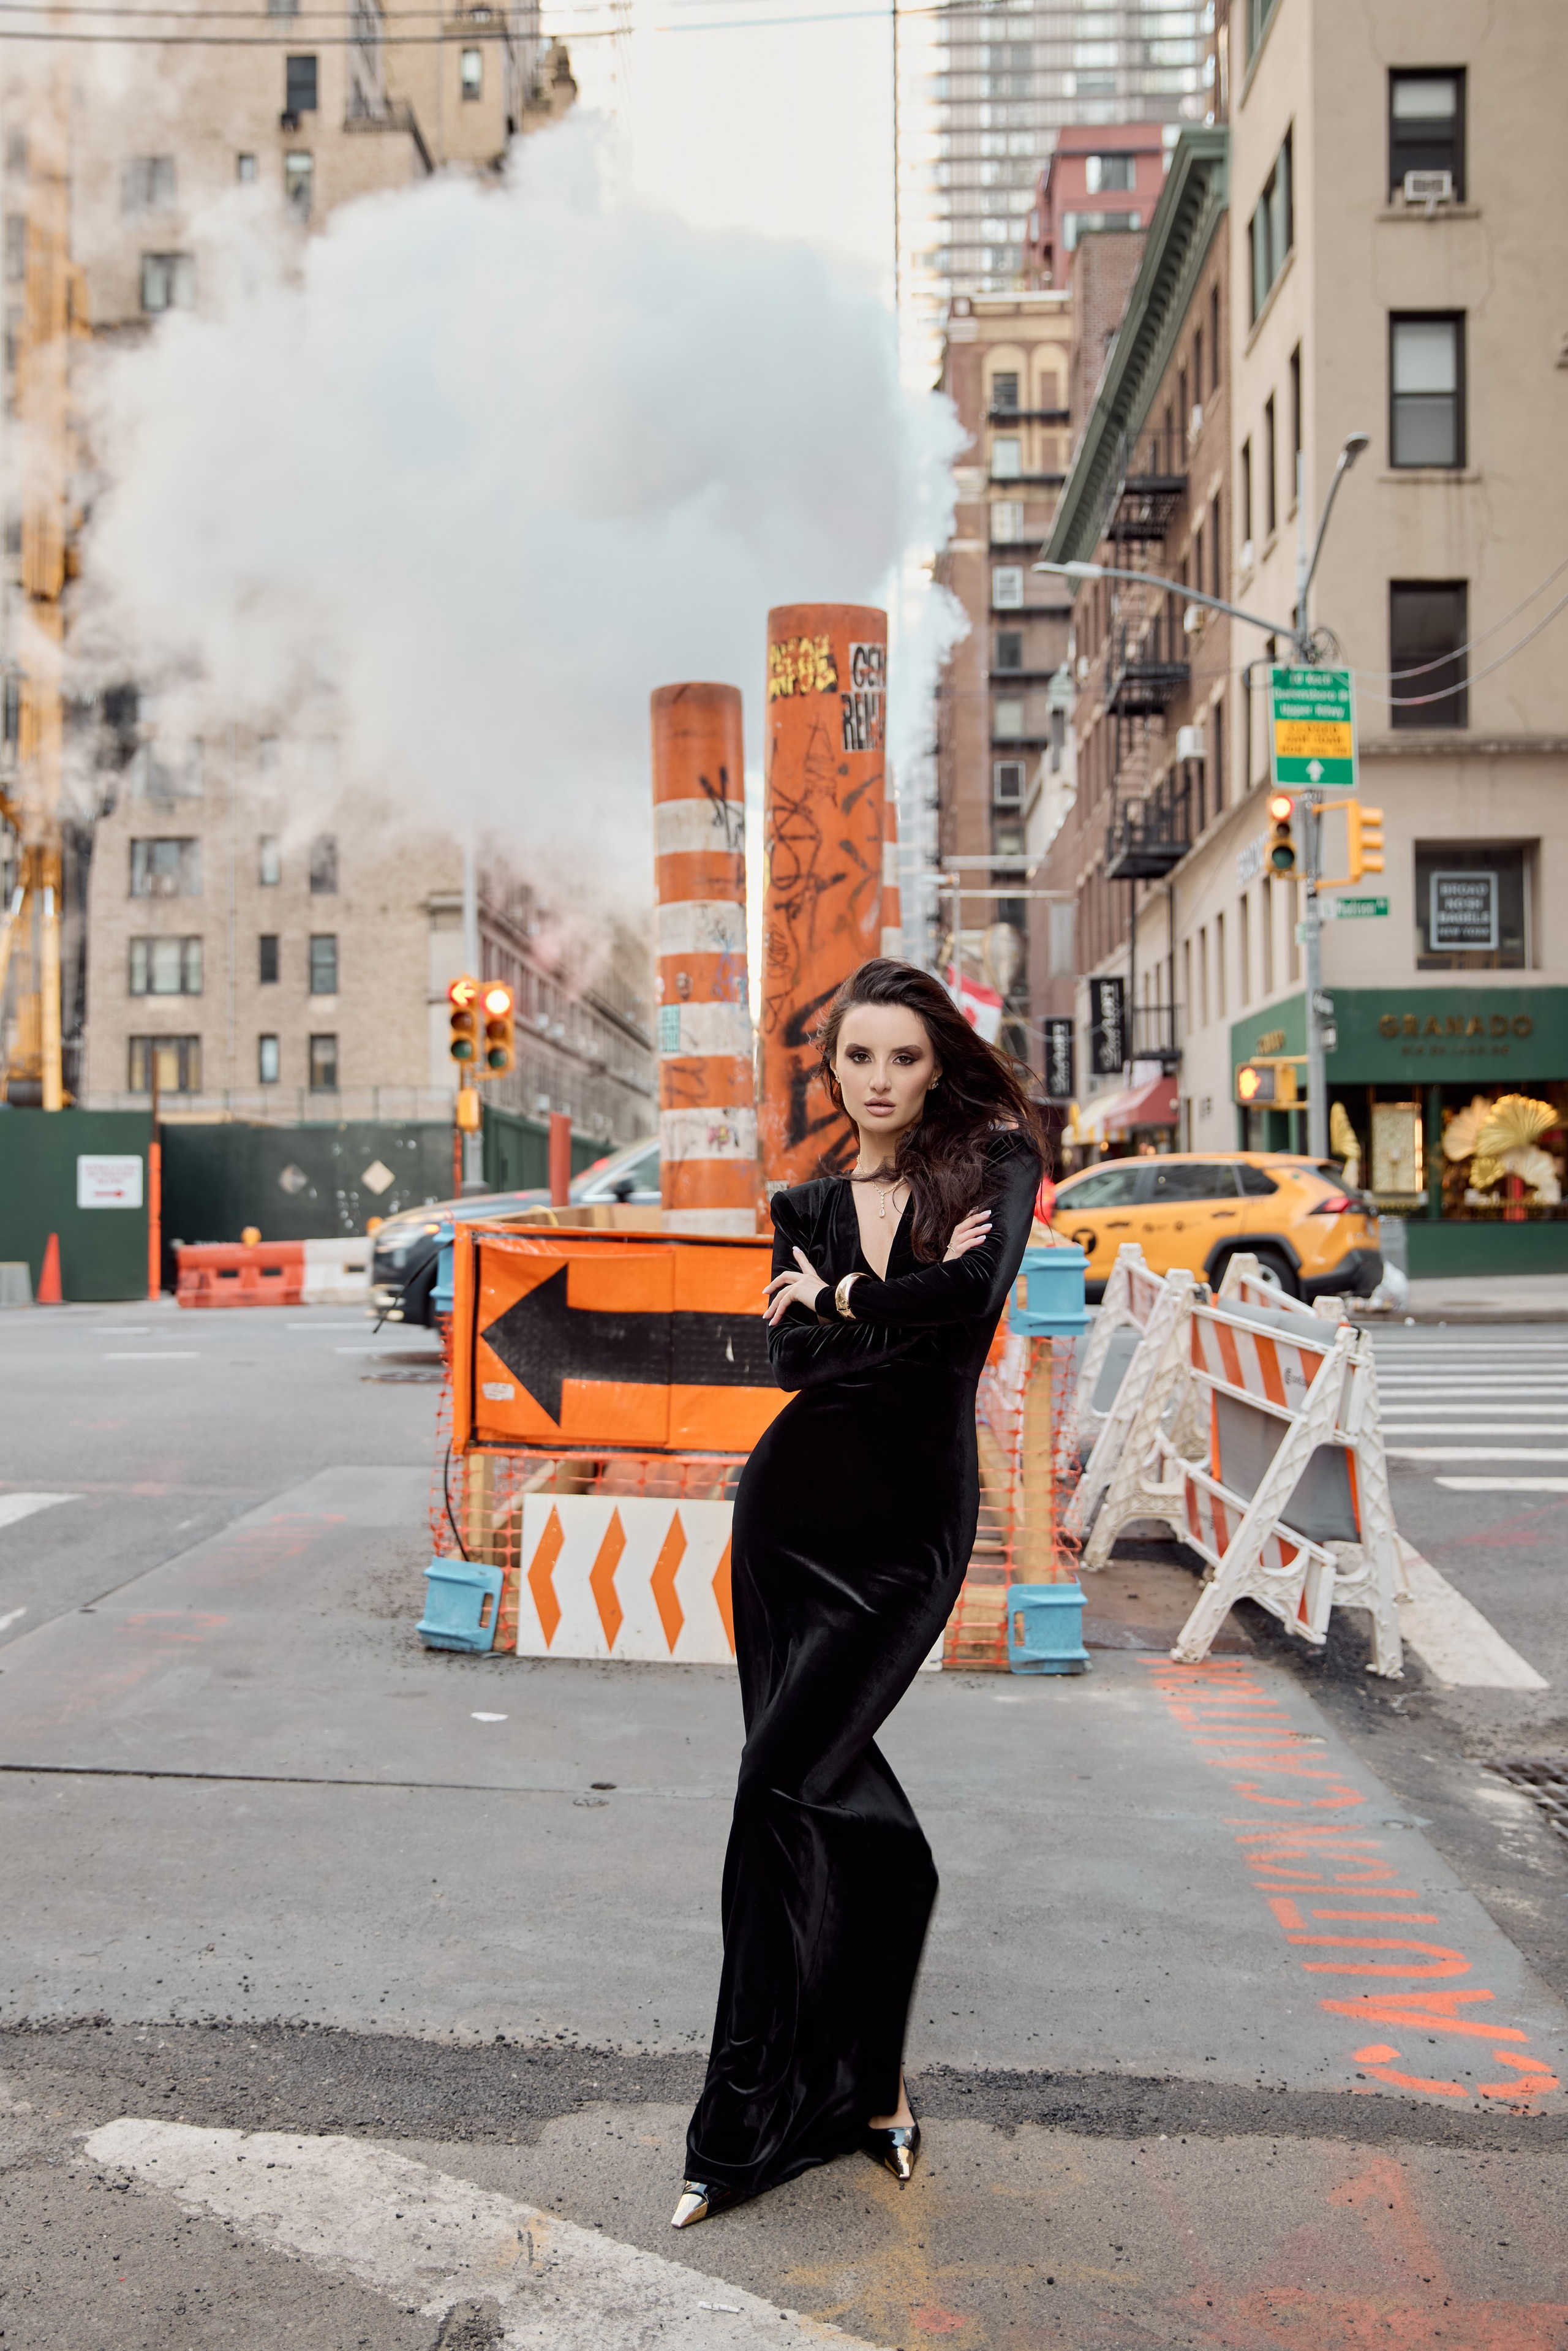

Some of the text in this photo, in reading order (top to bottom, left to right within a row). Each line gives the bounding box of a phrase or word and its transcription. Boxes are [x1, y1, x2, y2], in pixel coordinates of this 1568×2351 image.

[1379, 1014, 1532, 1036] GRANADO
[1136, 1658, 1368, 1808] CAUTION
[1223, 1818, 1559, 2099] CAUTION
